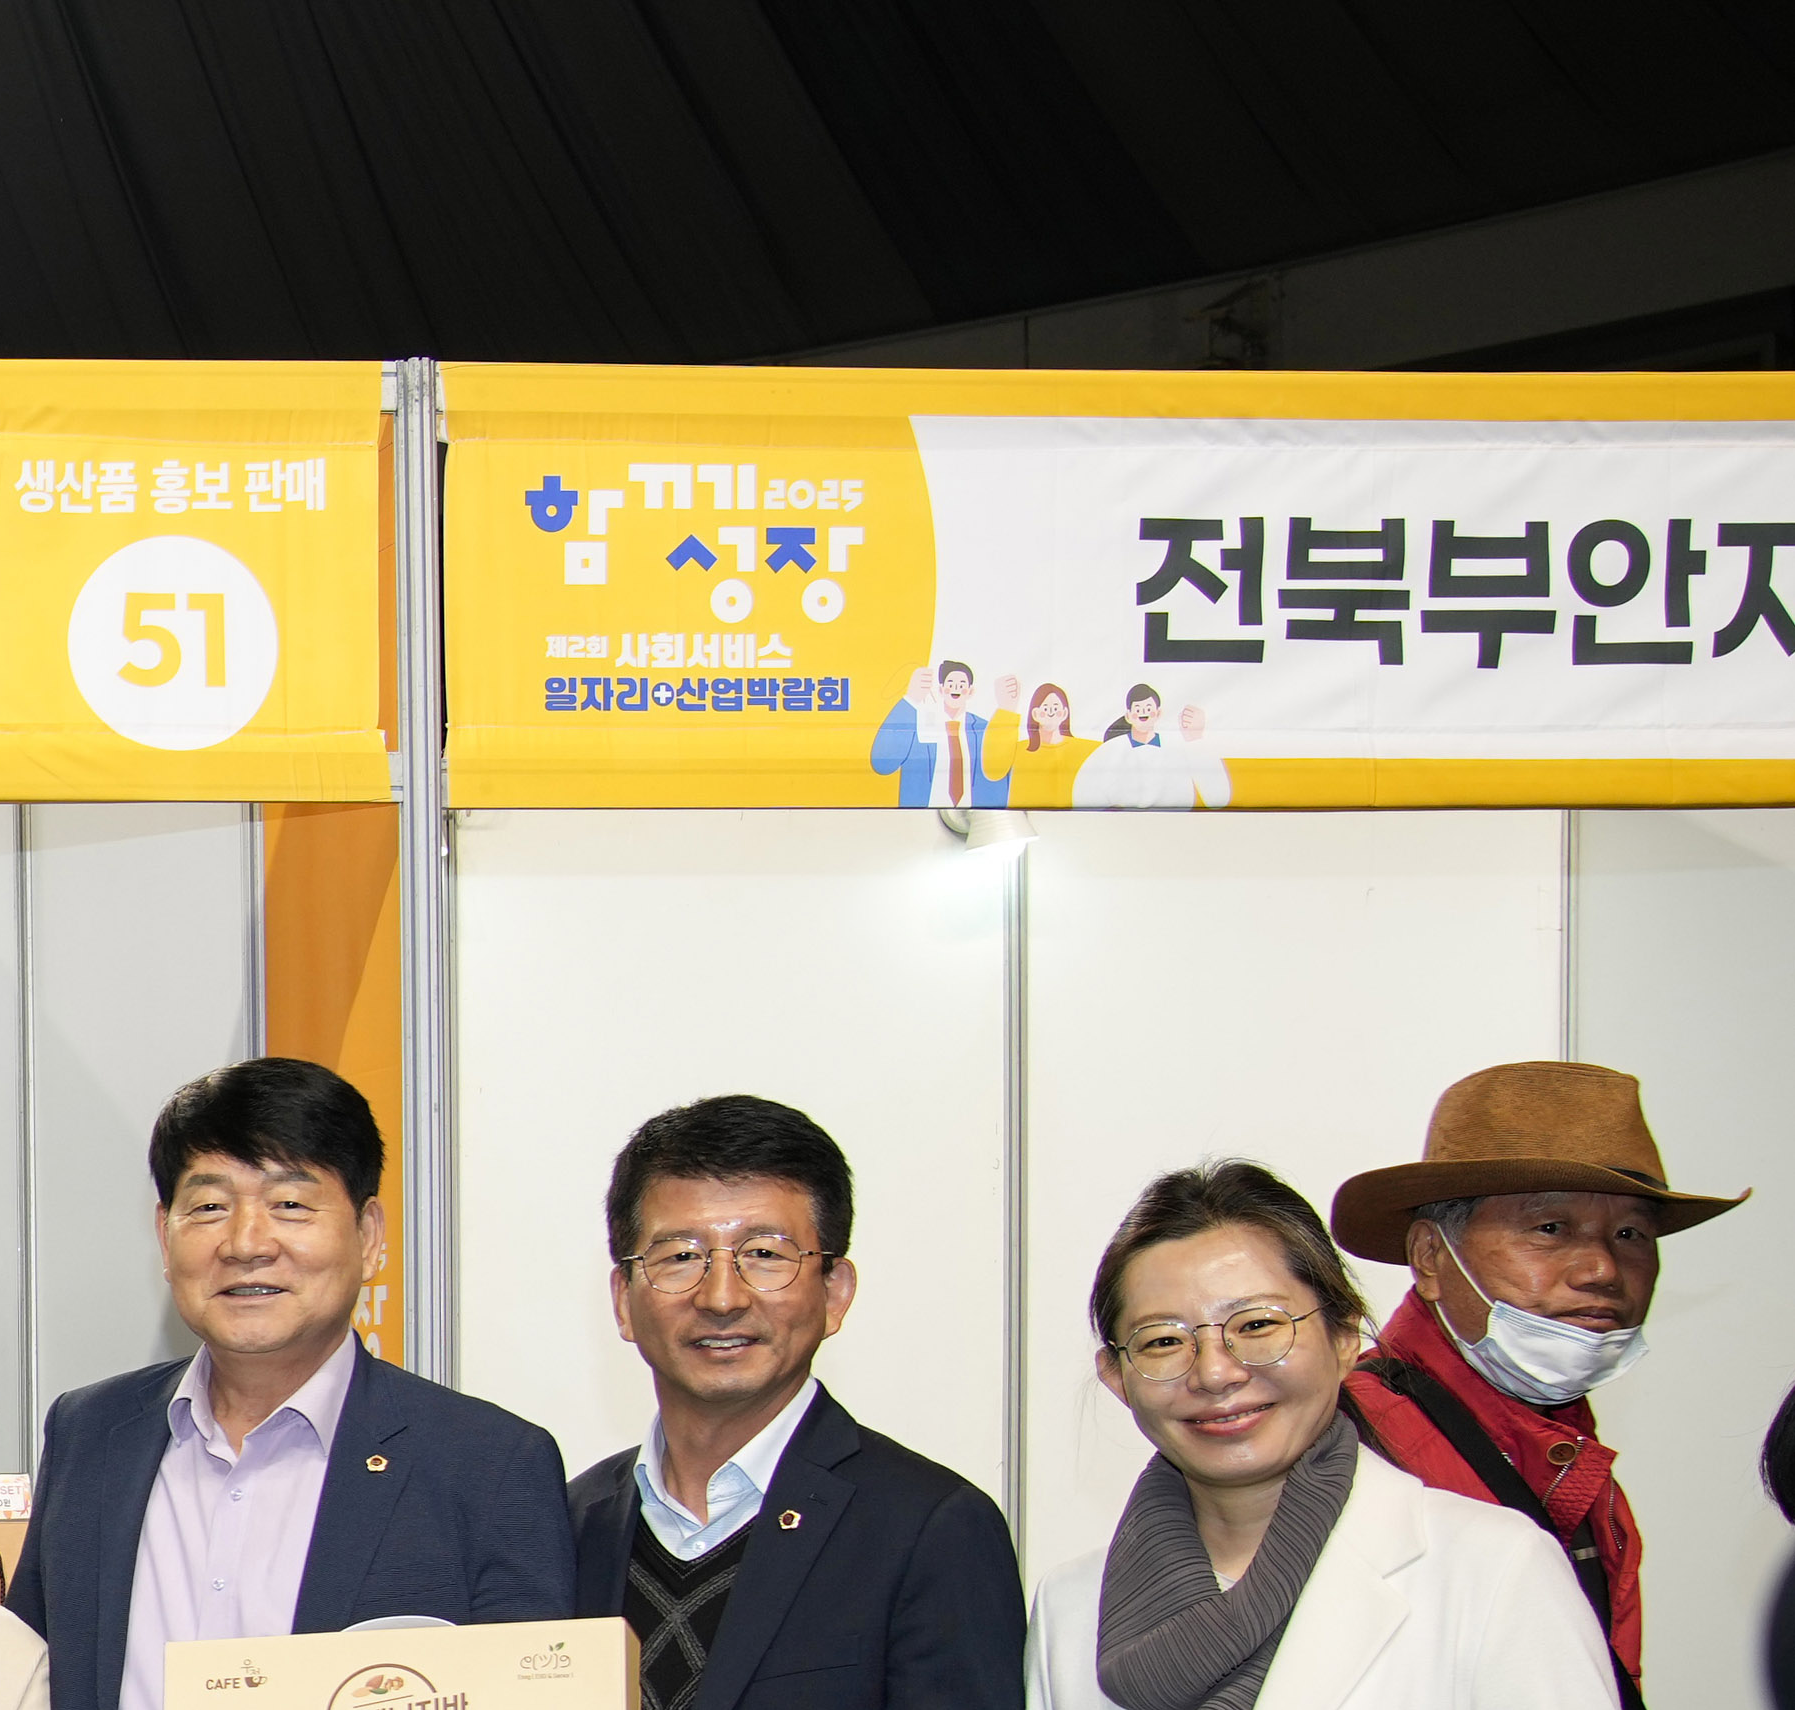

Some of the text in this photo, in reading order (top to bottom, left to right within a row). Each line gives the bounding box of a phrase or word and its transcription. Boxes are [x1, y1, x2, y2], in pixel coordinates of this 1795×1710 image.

[13, 457, 327, 515] 생산품 홍보 판매
[763, 477, 865, 512] 2025
[115, 592, 228, 689] 51
[545, 631, 794, 672] 제2회 사회서비스
[205, 1677, 242, 1691] CAFE
